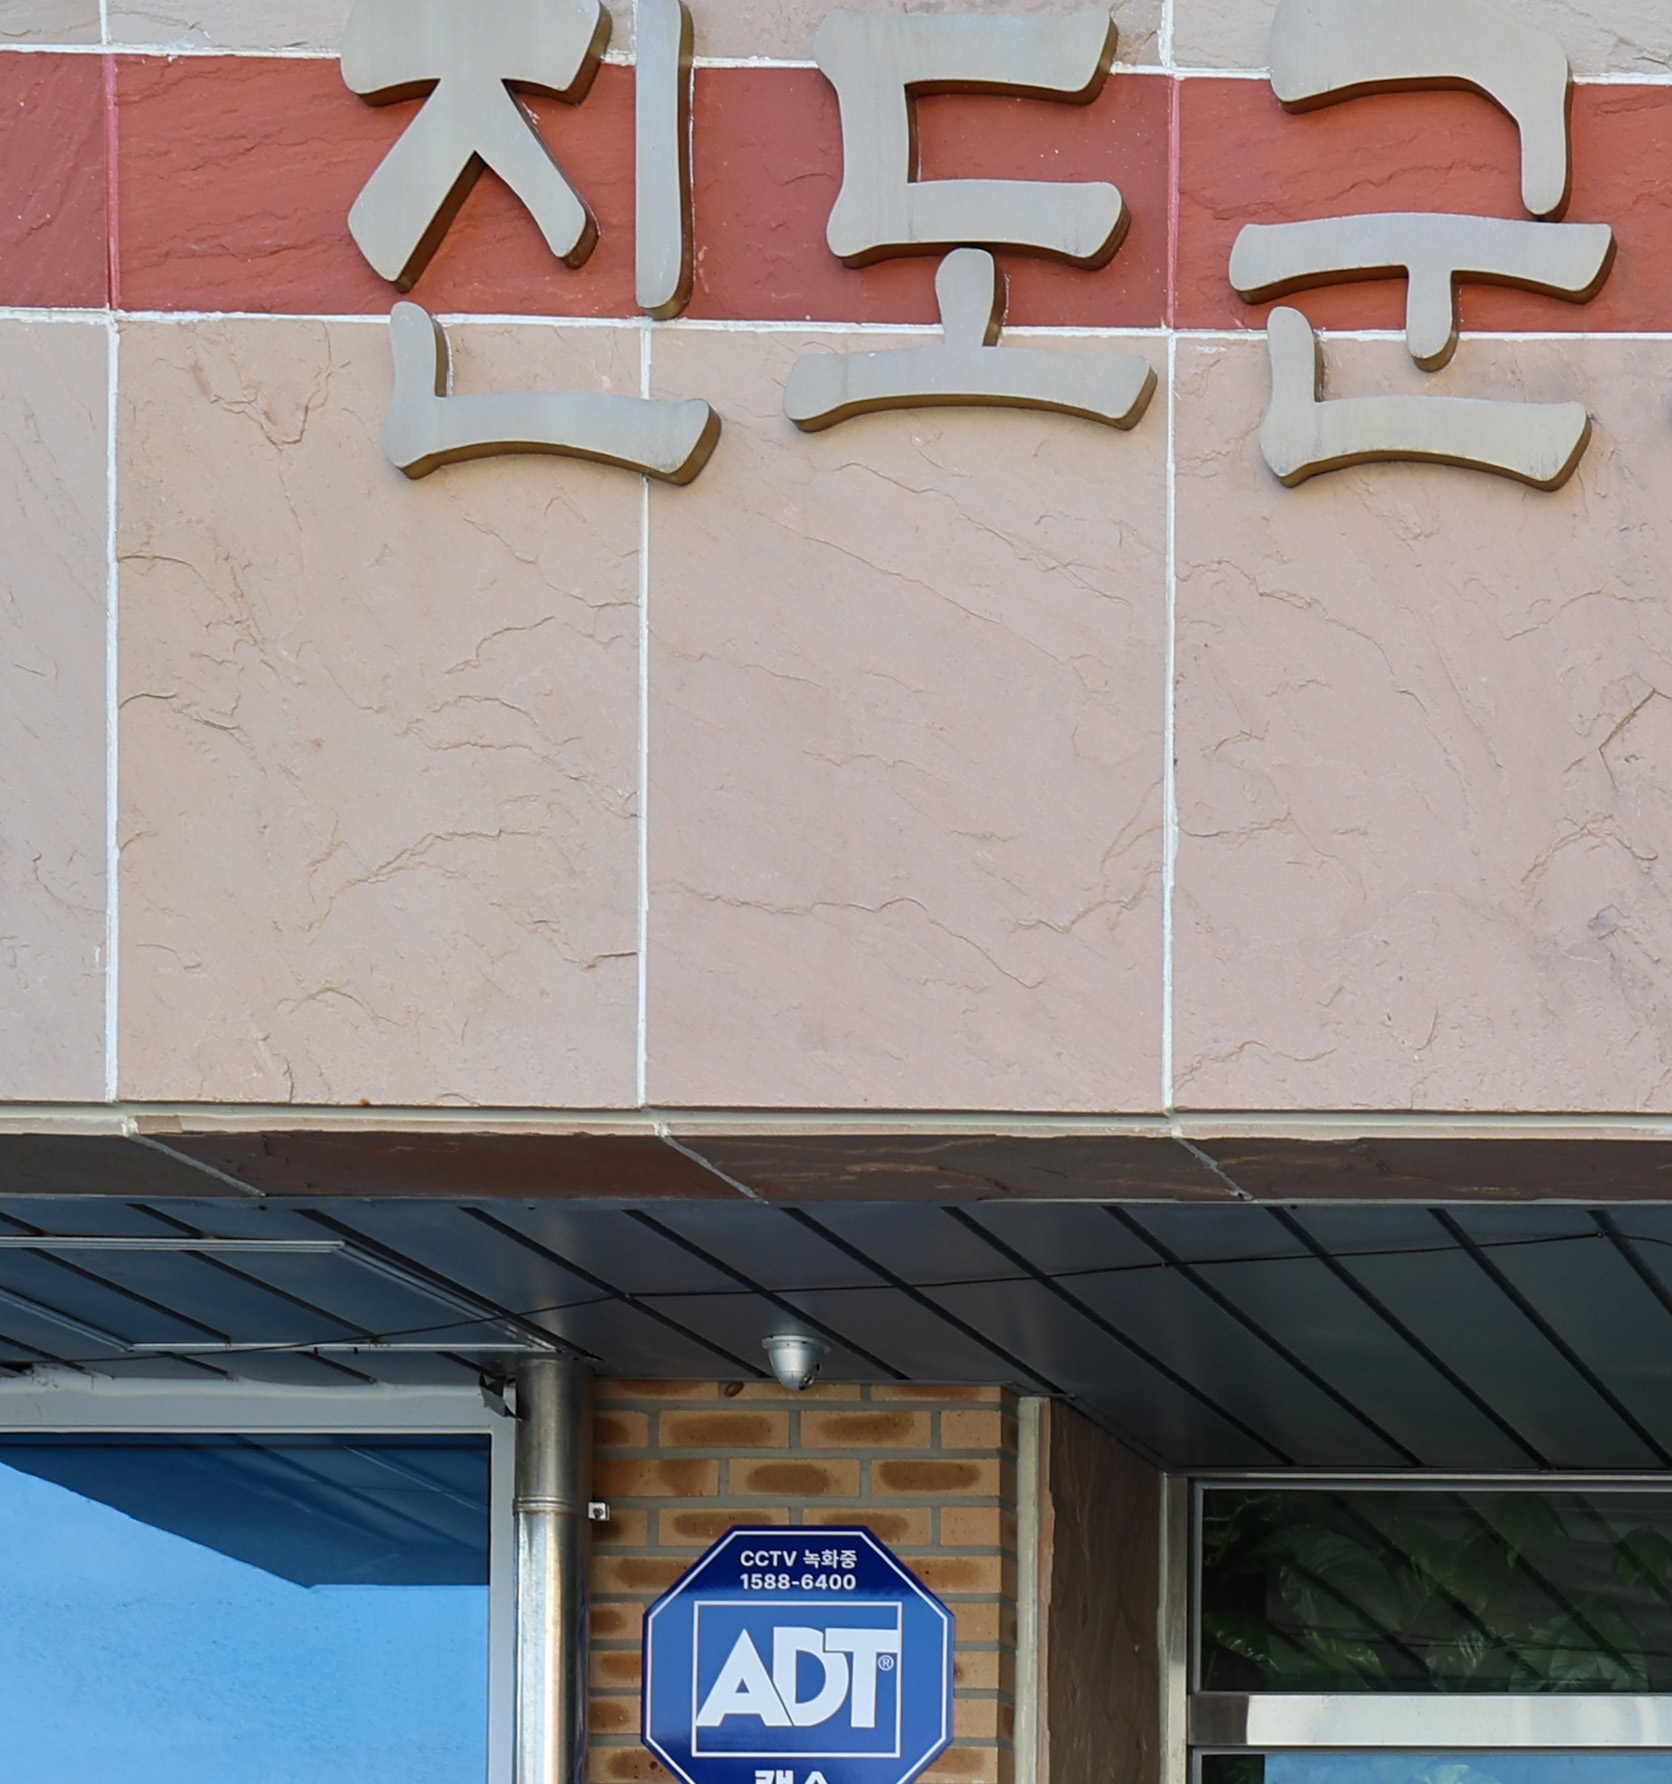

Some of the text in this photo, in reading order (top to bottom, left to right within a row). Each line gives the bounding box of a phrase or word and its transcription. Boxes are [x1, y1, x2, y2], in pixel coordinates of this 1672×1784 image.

[740, 1550, 857, 1568] CCTV 녹화중
[740, 1574, 856, 1590] 1588-6400
[695, 1626, 899, 1728] ADT
